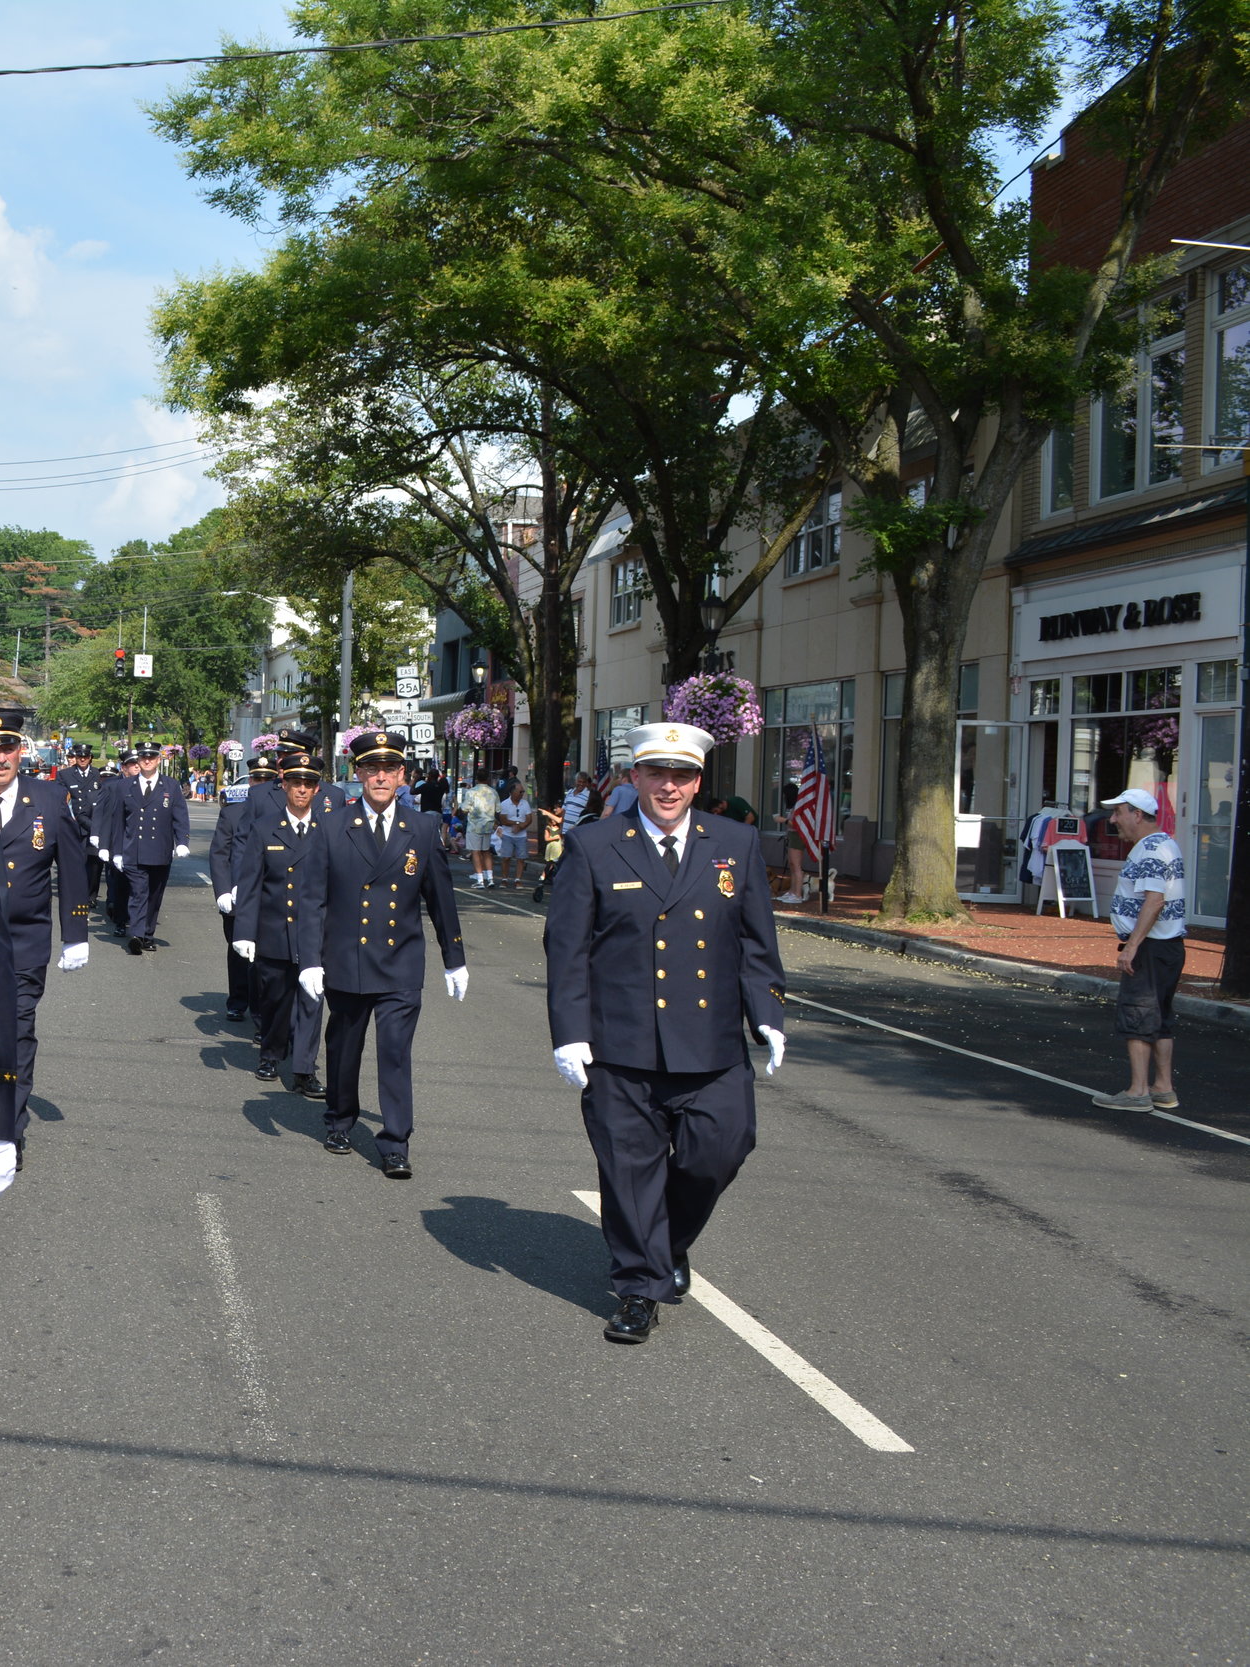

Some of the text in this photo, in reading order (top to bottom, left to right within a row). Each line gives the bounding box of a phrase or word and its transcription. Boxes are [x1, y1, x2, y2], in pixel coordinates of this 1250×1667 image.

[1038, 591, 1202, 642] RUNWAY & ROSE
[400, 668, 415, 676] EAST
[398, 682, 419, 694] 25A
[387, 714, 406, 722] NORTH
[413, 713, 432, 721] SOUTH
[415, 728, 432, 739] 110
[228, 788, 248, 797] POLICE
